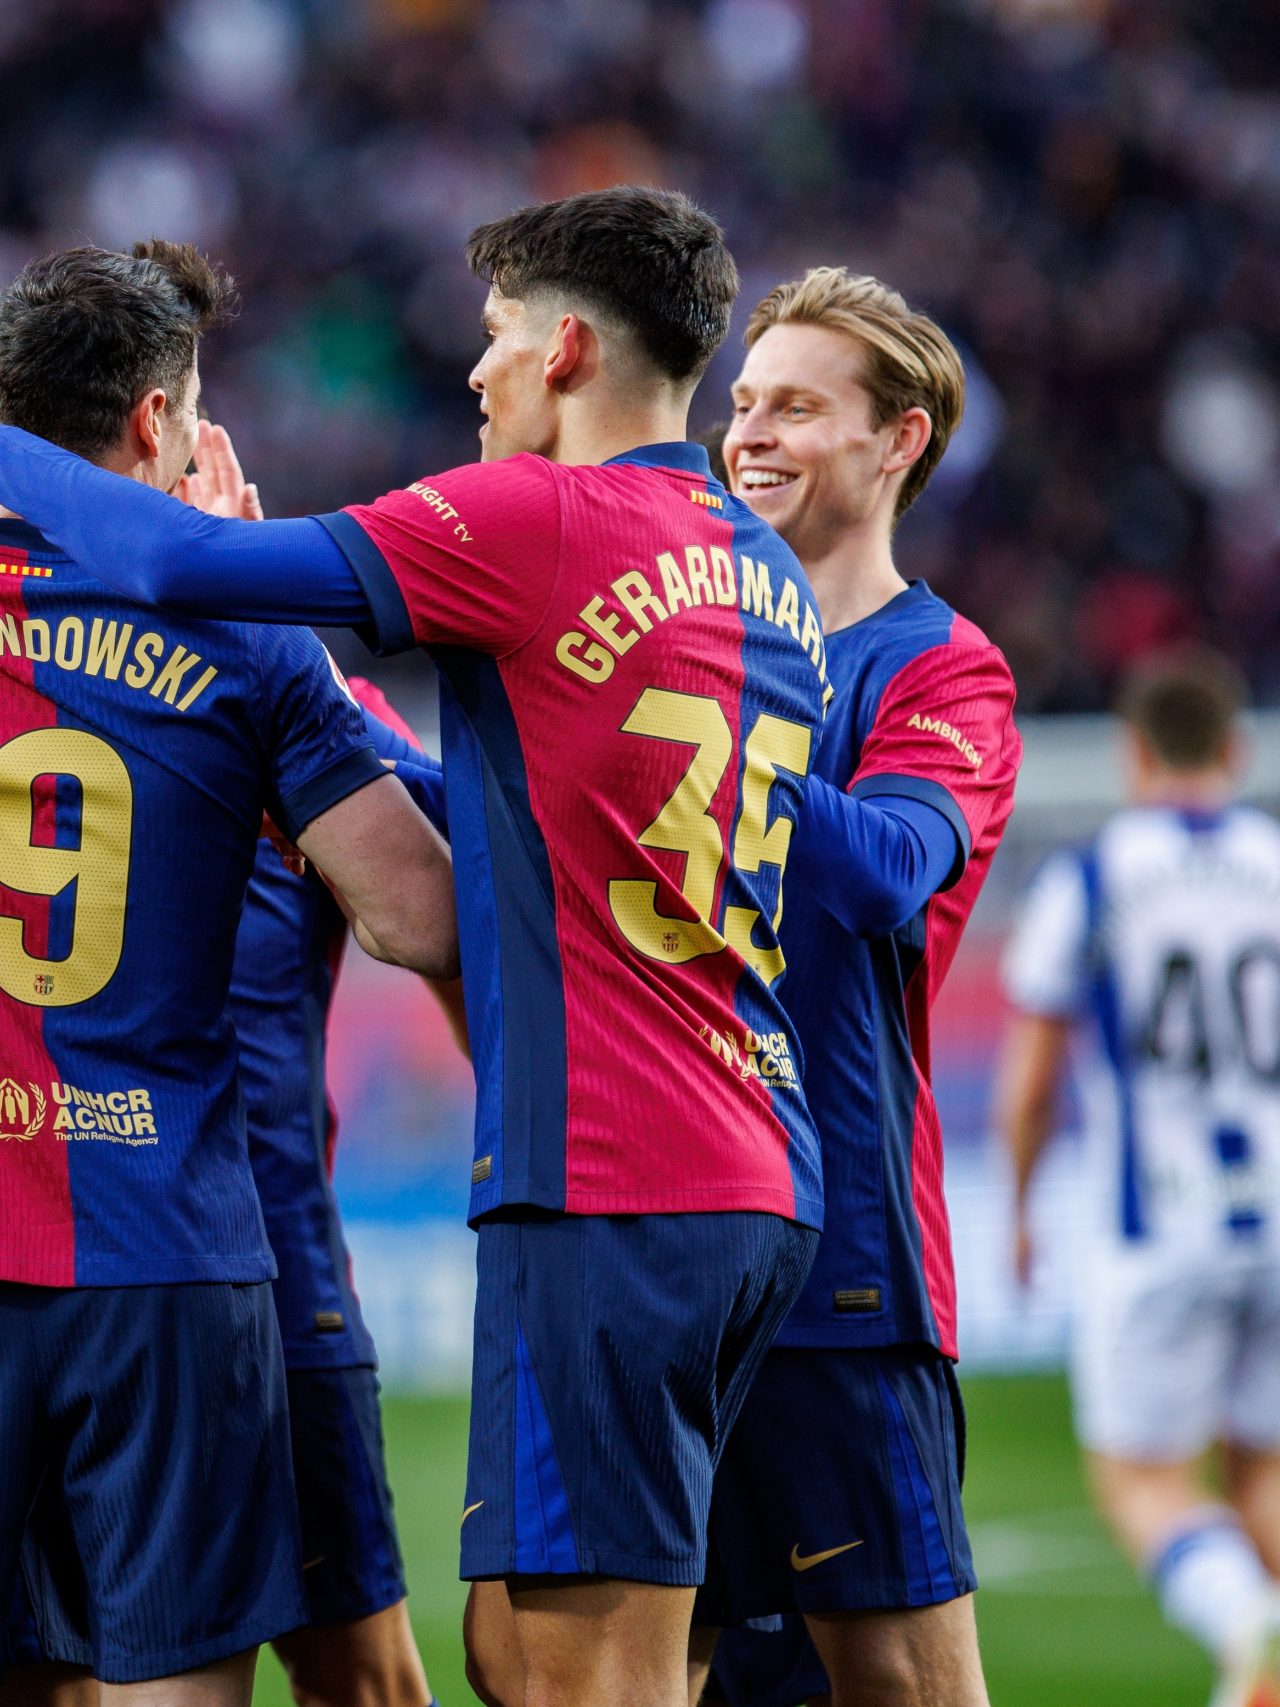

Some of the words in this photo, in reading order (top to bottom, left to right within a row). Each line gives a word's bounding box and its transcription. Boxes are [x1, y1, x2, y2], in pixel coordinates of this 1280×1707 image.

[555, 544, 738, 685] GERARD
[608, 686, 812, 986] 35
[51, 1081, 153, 1116] UNHCR
[52, 1106, 157, 1137] ACNUR
[54, 1132, 71, 1142] The
[74, 1132, 90, 1141] UN
[91, 1132, 124, 1145] Refugee
[125, 1136, 159, 1147] Agency
